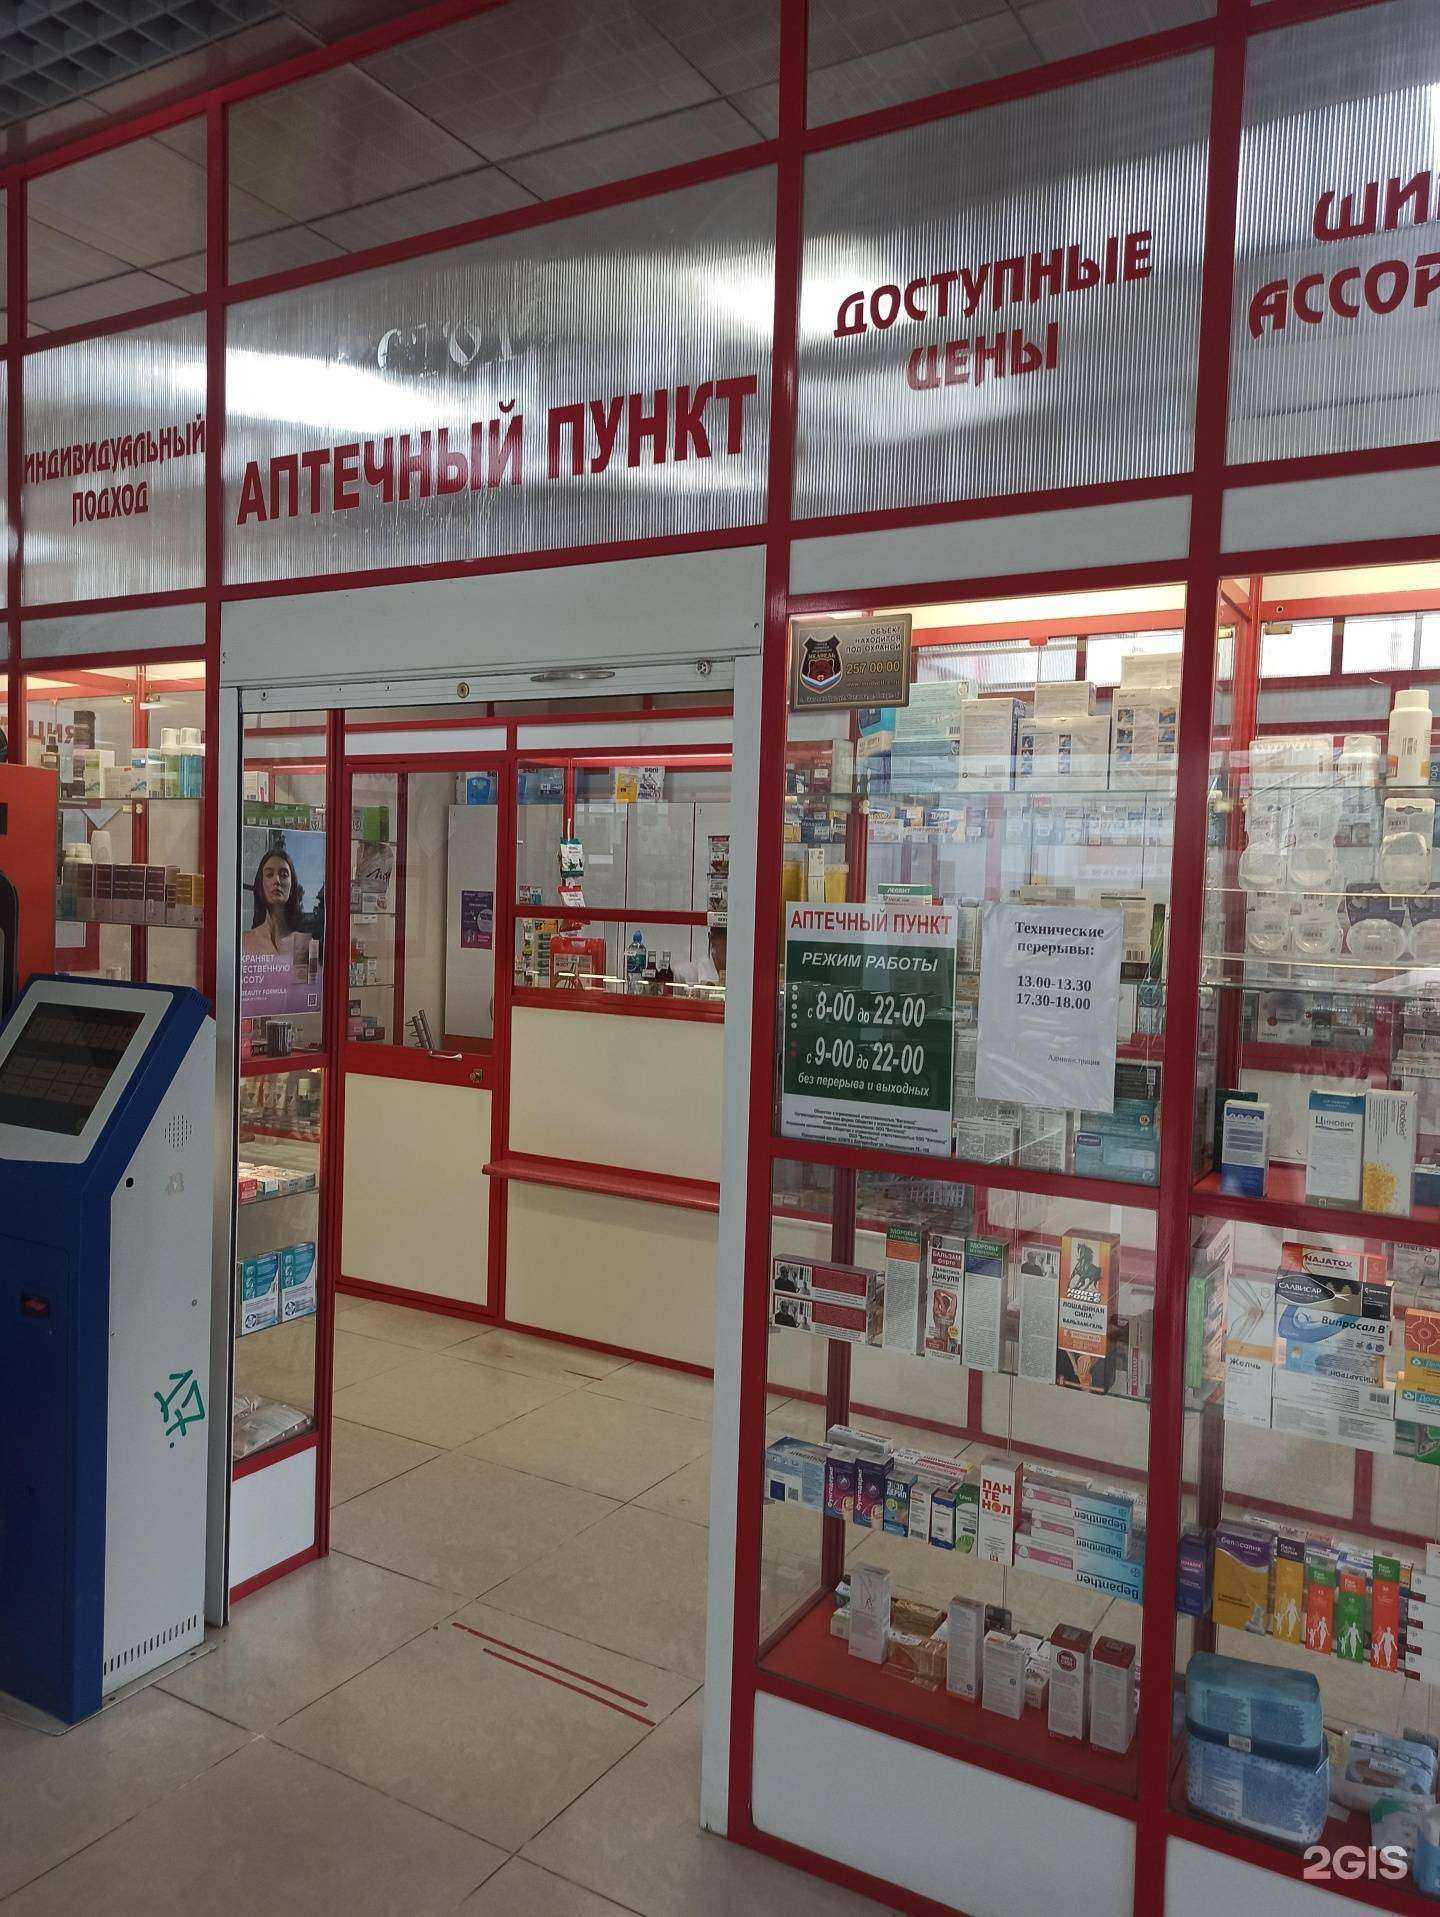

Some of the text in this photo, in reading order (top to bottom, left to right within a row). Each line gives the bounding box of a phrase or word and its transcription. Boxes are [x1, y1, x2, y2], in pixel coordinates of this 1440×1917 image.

[1313, 171, 1440, 242] ШИ
[834, 230, 1152, 338] ДОСТУПНЫЕ
[906, 323, 1058, 391] ЦЕНЫ
[24, 414, 206, 483] ИНДИВИДУАЛЬНЫЙ
[237, 375, 757, 525] АПТЕЧНЫЙ ПУНКТ
[73, 481, 149, 526] ПОДХОД
[869, 661, 884, 673] 00
[886, 660, 900, 673] 00
[791, 907, 952, 935] АПТЕЧНЫЙ ПУНКТ
[1015, 921, 1105, 938] Технические
[1017, 940, 1095, 956] перерывы:
[802, 952, 938, 972] РЕЖИМ РАБОТЫ
[242, 975, 265, 984] СОТУ
[1017, 975, 1092, 992] 13.00-13.30
[807, 991, 925, 1028] с 8-00 до 22-00
[1016, 993, 1091, 1010] 17.30-18.00
[806, 1036, 924, 1075] с 9-00 до 22-00
[1047, 1054, 1100, 1067] Администрация
[798, 1072, 929, 1097] без перерыва и выходных
[933, 1251, 961, 1261] БАЛЬЗАМ
[1304, 1253, 1353, 1269] NAJATOX
[1278, 1281, 1322, 1295] САЛВИСАР
[1321, 1315, 1376, 1334] Випросал
[982, 1478, 1012, 1495] ПАН
[982, 1489, 1000, 1502] ТЕ
[981, 1500, 1012, 1516] НОЛ
[1076, 1573, 1140, 1600] Bepanthen
